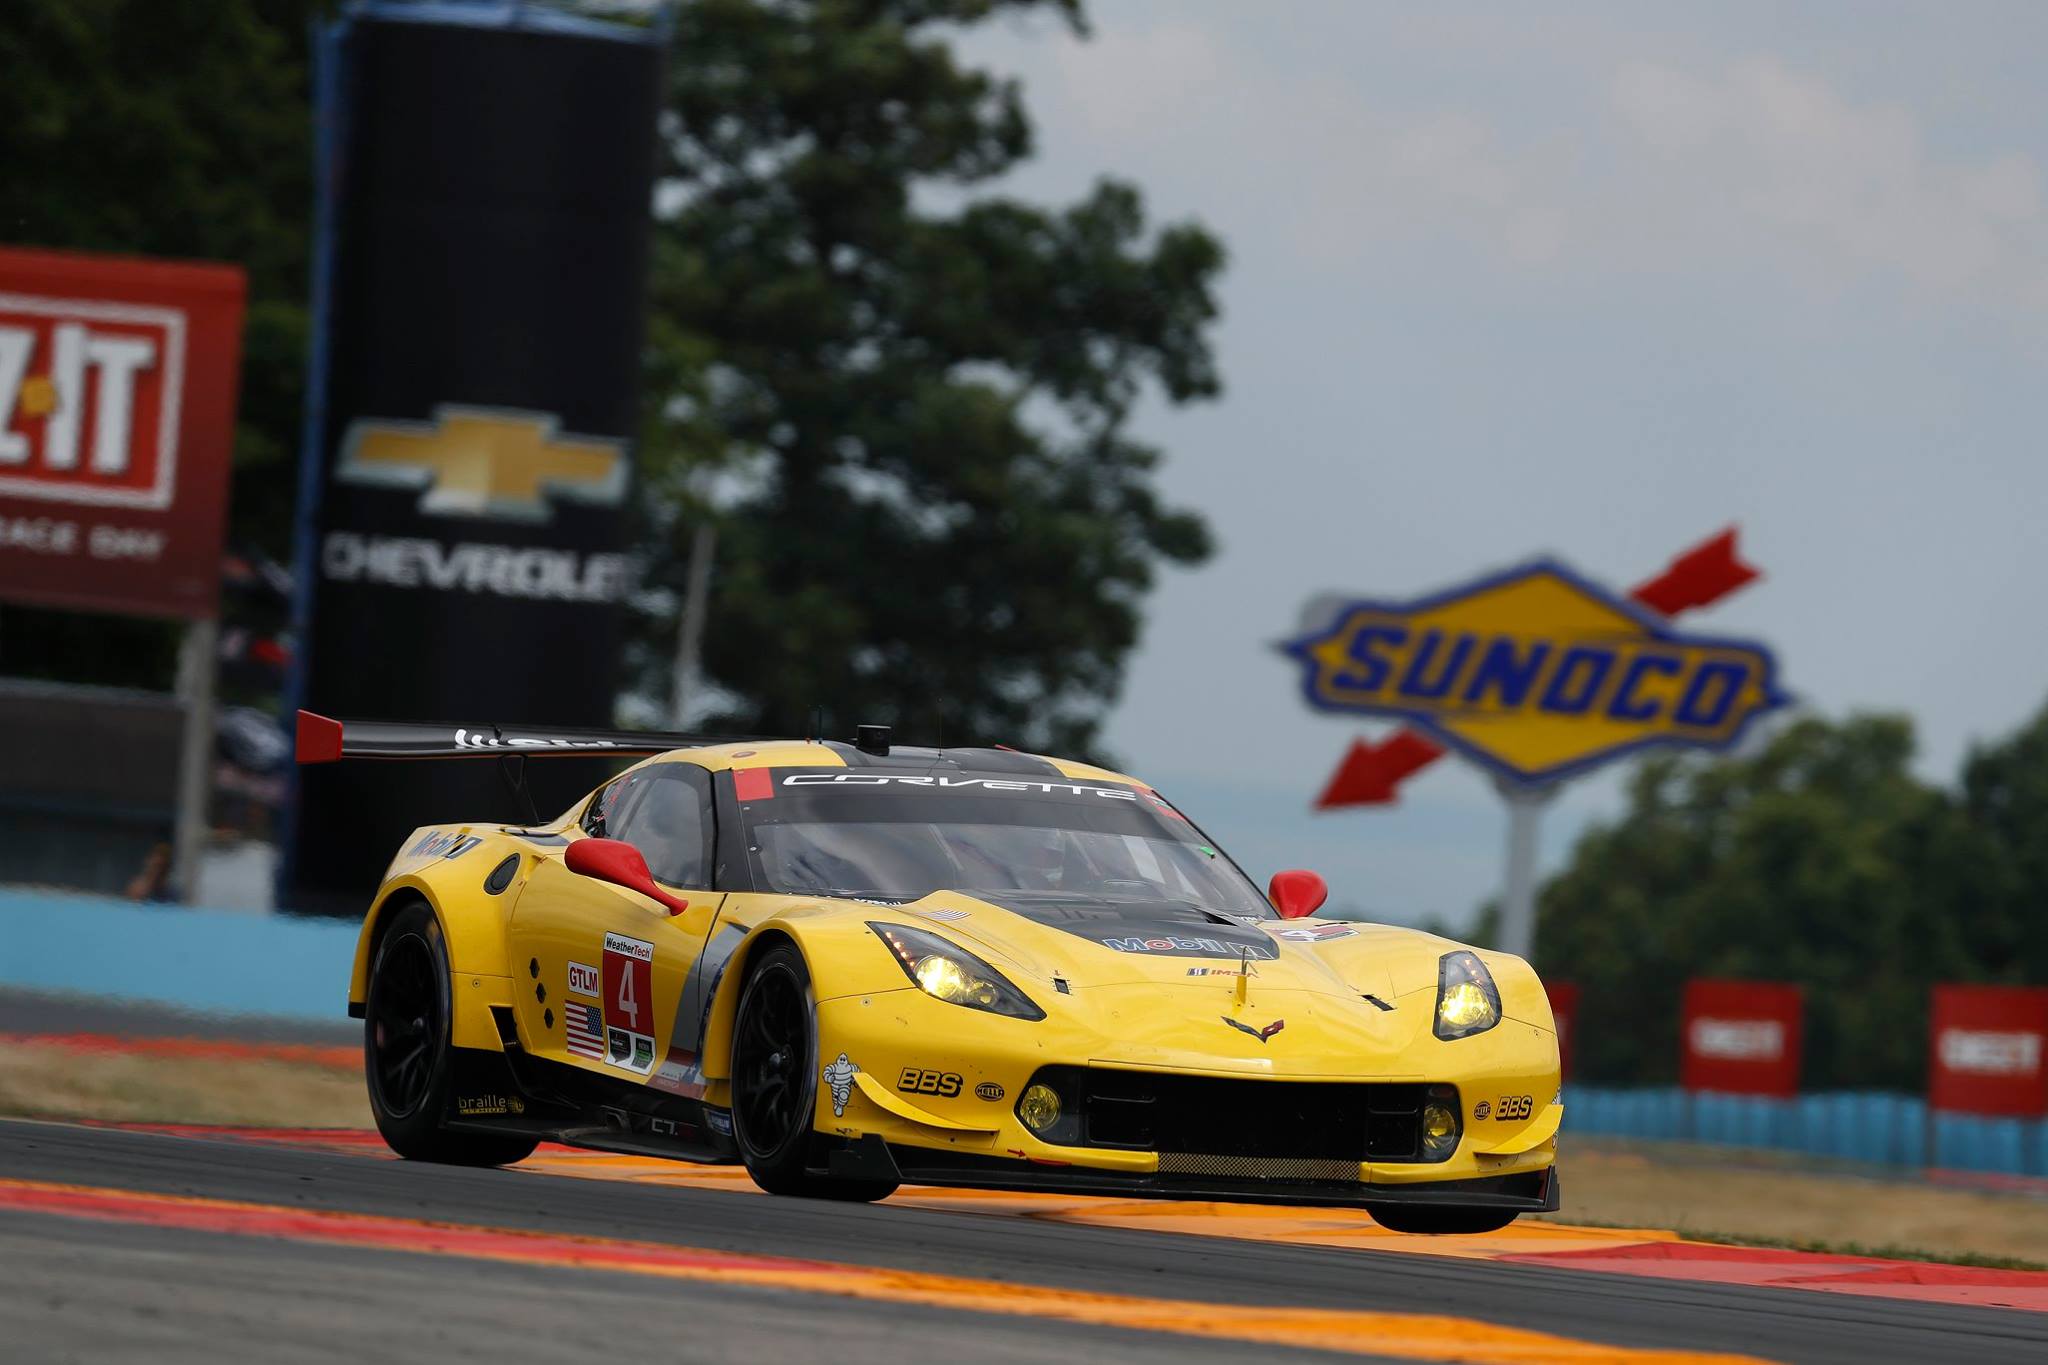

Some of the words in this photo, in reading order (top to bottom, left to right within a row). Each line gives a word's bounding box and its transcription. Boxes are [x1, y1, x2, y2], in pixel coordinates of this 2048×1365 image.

[0, 514, 78, 554] ACE
[1330, 626, 1749, 728] SUNOCO
[782, 774, 1137, 801] CORVETTE
[606, 937, 651, 958] WeatherTech
[1102, 936, 1227, 954] Mobil
[569, 966, 598, 992] GTLM
[617, 960, 638, 1028] 4
[897, 1067, 963, 1098] BBS
[459, 1095, 506, 1109] braille
[1495, 1095, 1533, 1121] BBS
